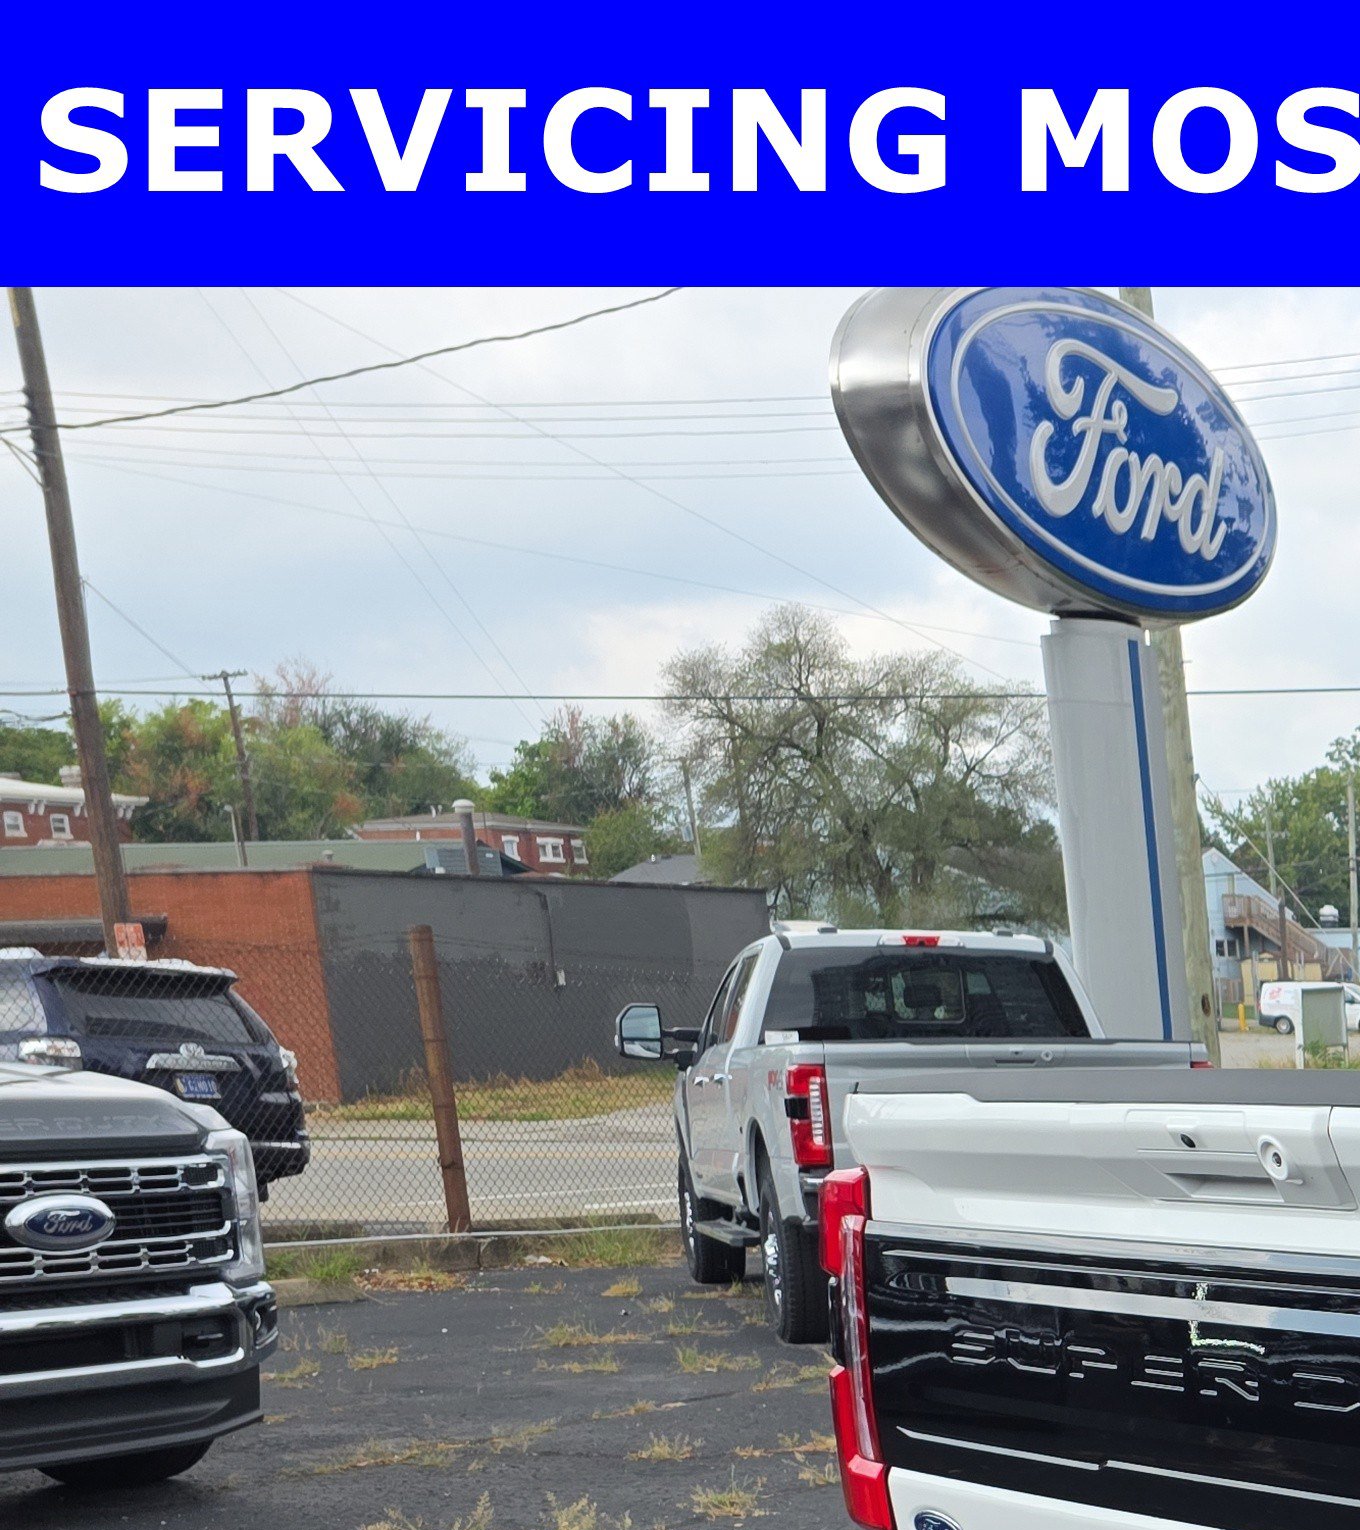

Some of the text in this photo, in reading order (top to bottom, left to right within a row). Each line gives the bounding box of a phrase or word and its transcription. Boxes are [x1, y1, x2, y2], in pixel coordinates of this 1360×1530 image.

[1028, 338, 1228, 561] Ford
[43, 1209, 95, 1233] Ford
[951, 1328, 1261, 1403] SUPER
